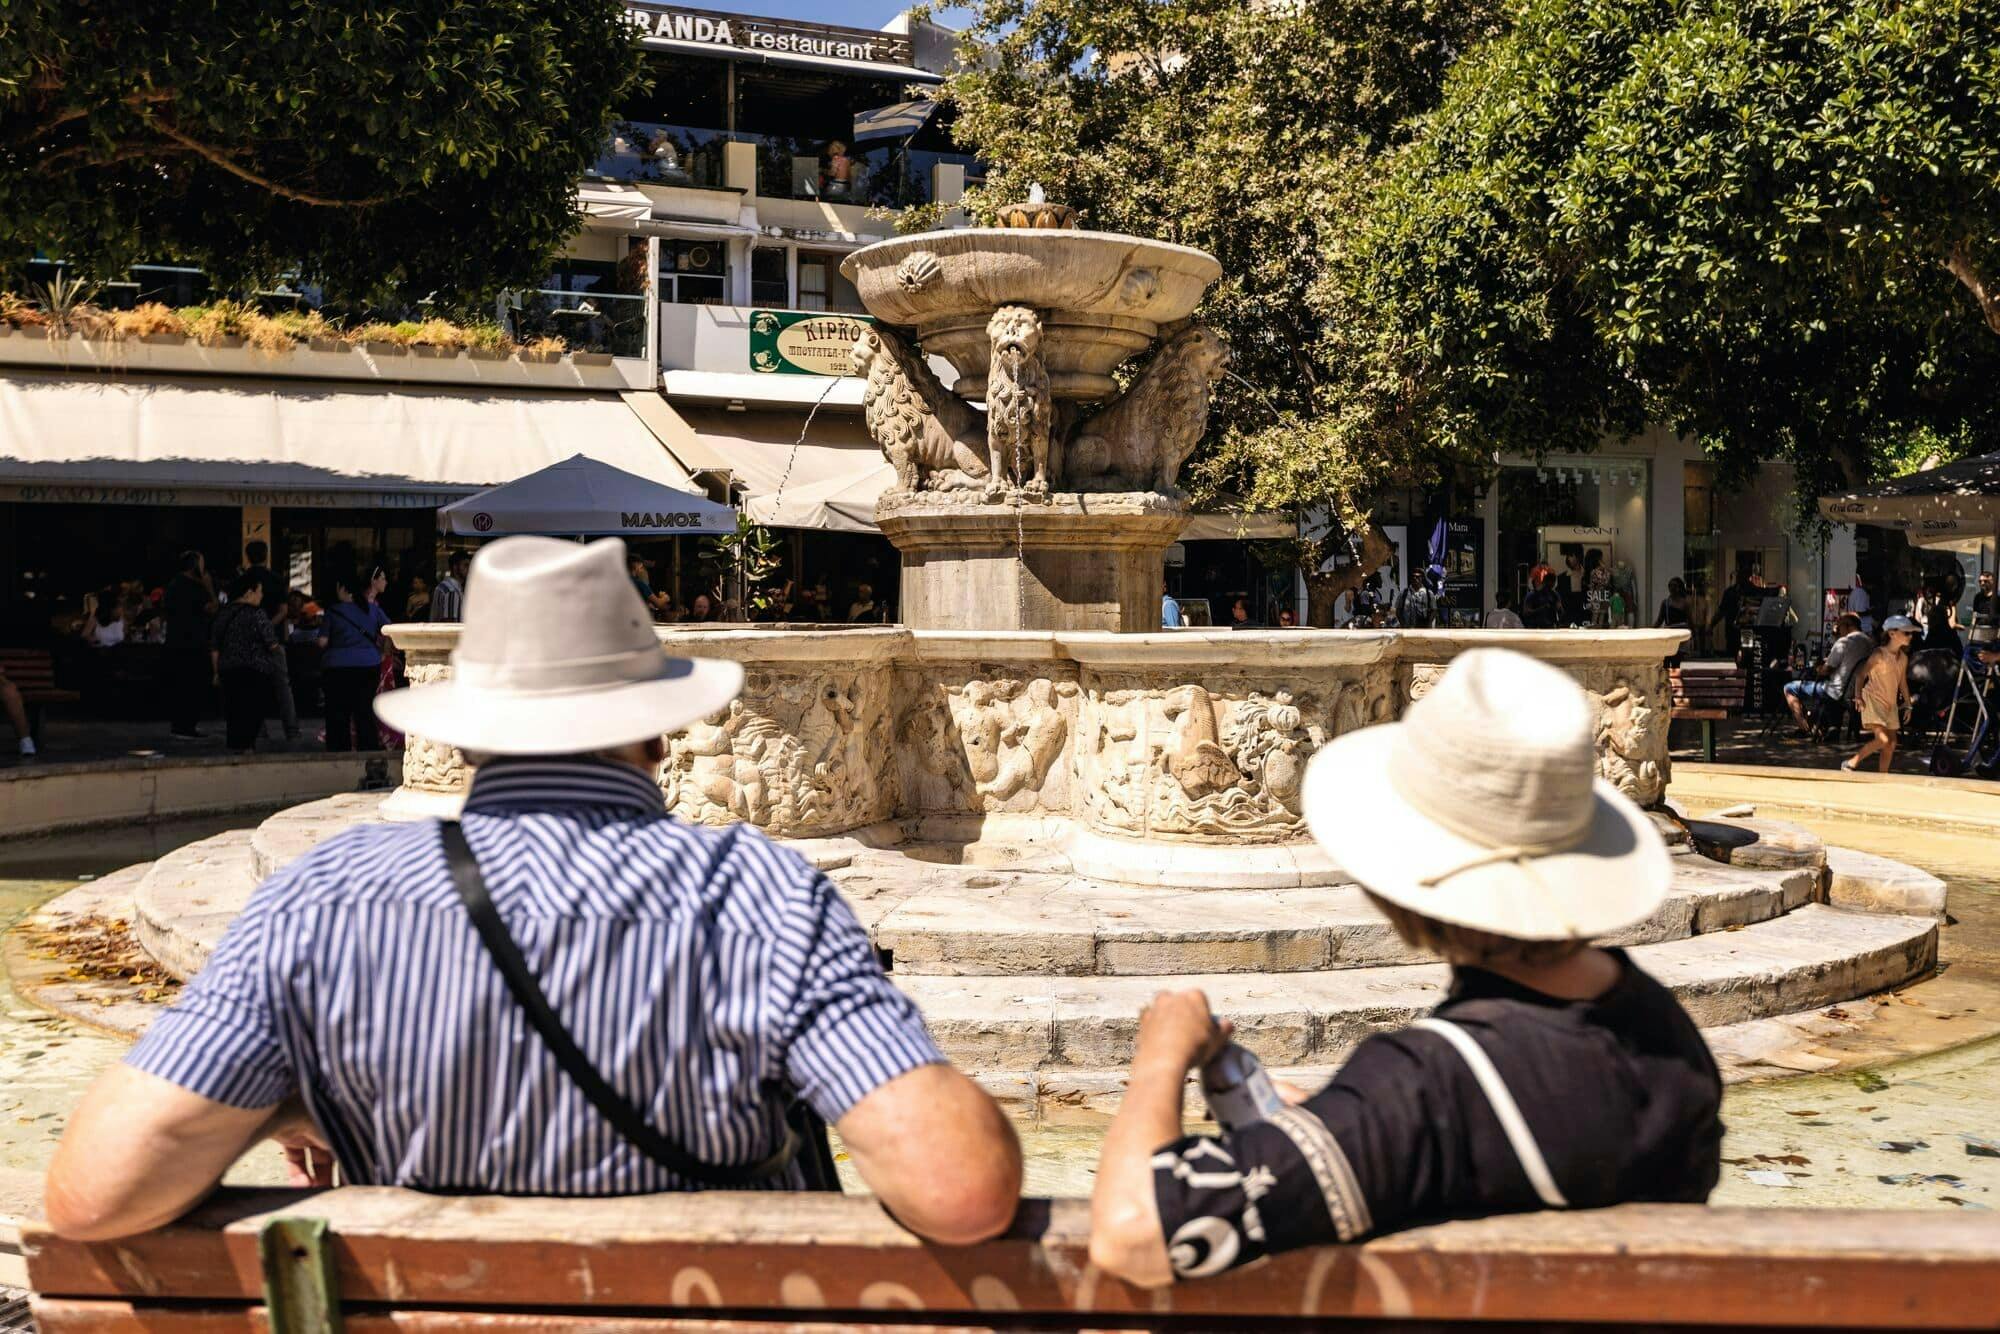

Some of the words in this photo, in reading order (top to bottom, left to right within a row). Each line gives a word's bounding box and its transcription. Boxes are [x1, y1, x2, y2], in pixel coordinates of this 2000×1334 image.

[623, 10, 734, 44] RANDA
[750, 33, 874, 60] restaurant
[803, 322, 861, 342] ΚΙΡΚΟ
[621, 512, 702, 528] ΜΑΜΟΣ
[1587, 590, 1610, 602] SALE
